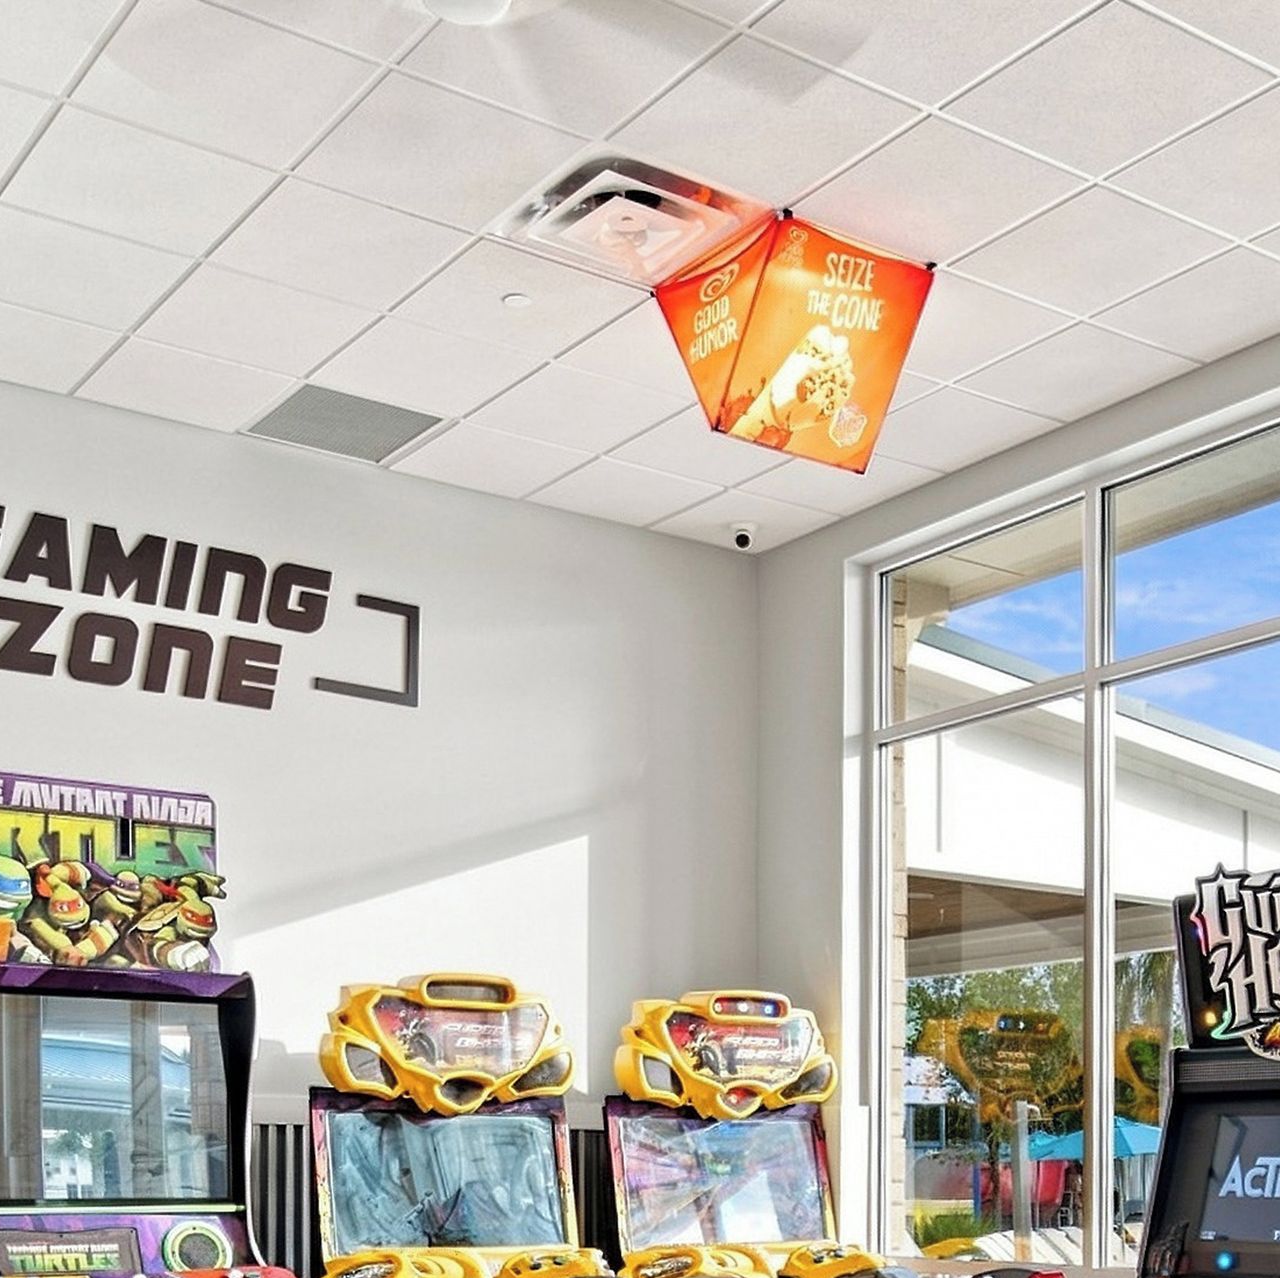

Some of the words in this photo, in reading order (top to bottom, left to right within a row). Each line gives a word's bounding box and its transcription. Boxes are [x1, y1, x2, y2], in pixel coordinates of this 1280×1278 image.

[823, 252, 876, 292] SEIZE
[694, 296, 730, 333] GOOD
[807, 290, 830, 316] THE
[831, 291, 885, 331] CONE
[689, 320, 738, 364] HUMOR
[11, 781, 130, 820] MUTANT
[133, 793, 214, 826] NINJA
[8, 1253, 121, 1273] TURTLES
